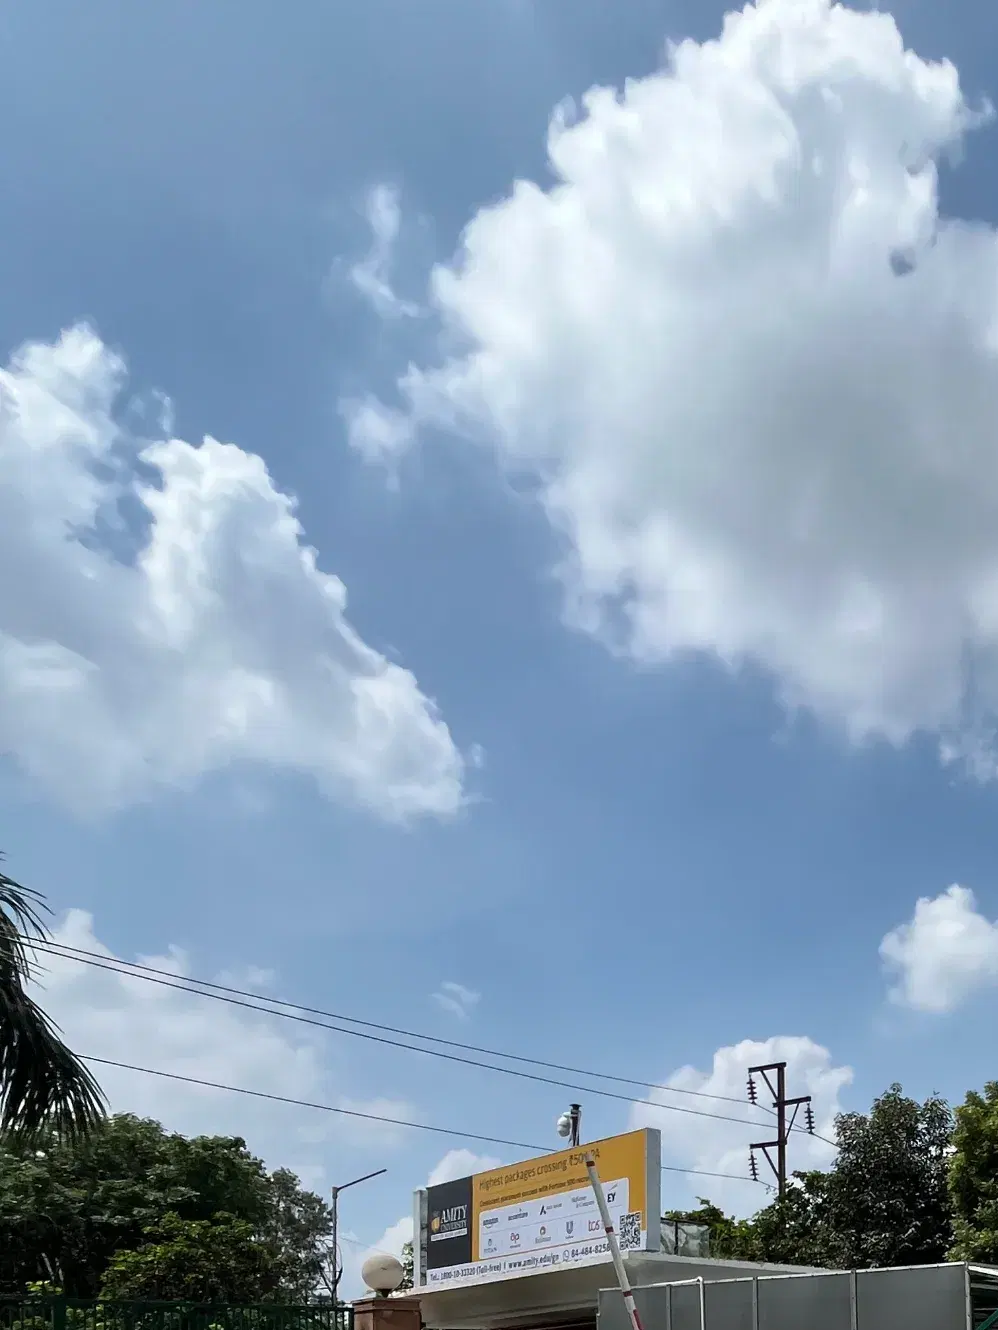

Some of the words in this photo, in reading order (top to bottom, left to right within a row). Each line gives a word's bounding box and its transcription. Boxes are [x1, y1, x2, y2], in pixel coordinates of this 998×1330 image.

[479, 1174, 503, 1190] Highest
[504, 1167, 535, 1186] packages
[536, 1158, 567, 1175] crossing
[607, 1192, 617, 1203] EY
[441, 1205, 467, 1224] AMITY
[440, 1220, 467, 1232] UNIVERSITY
